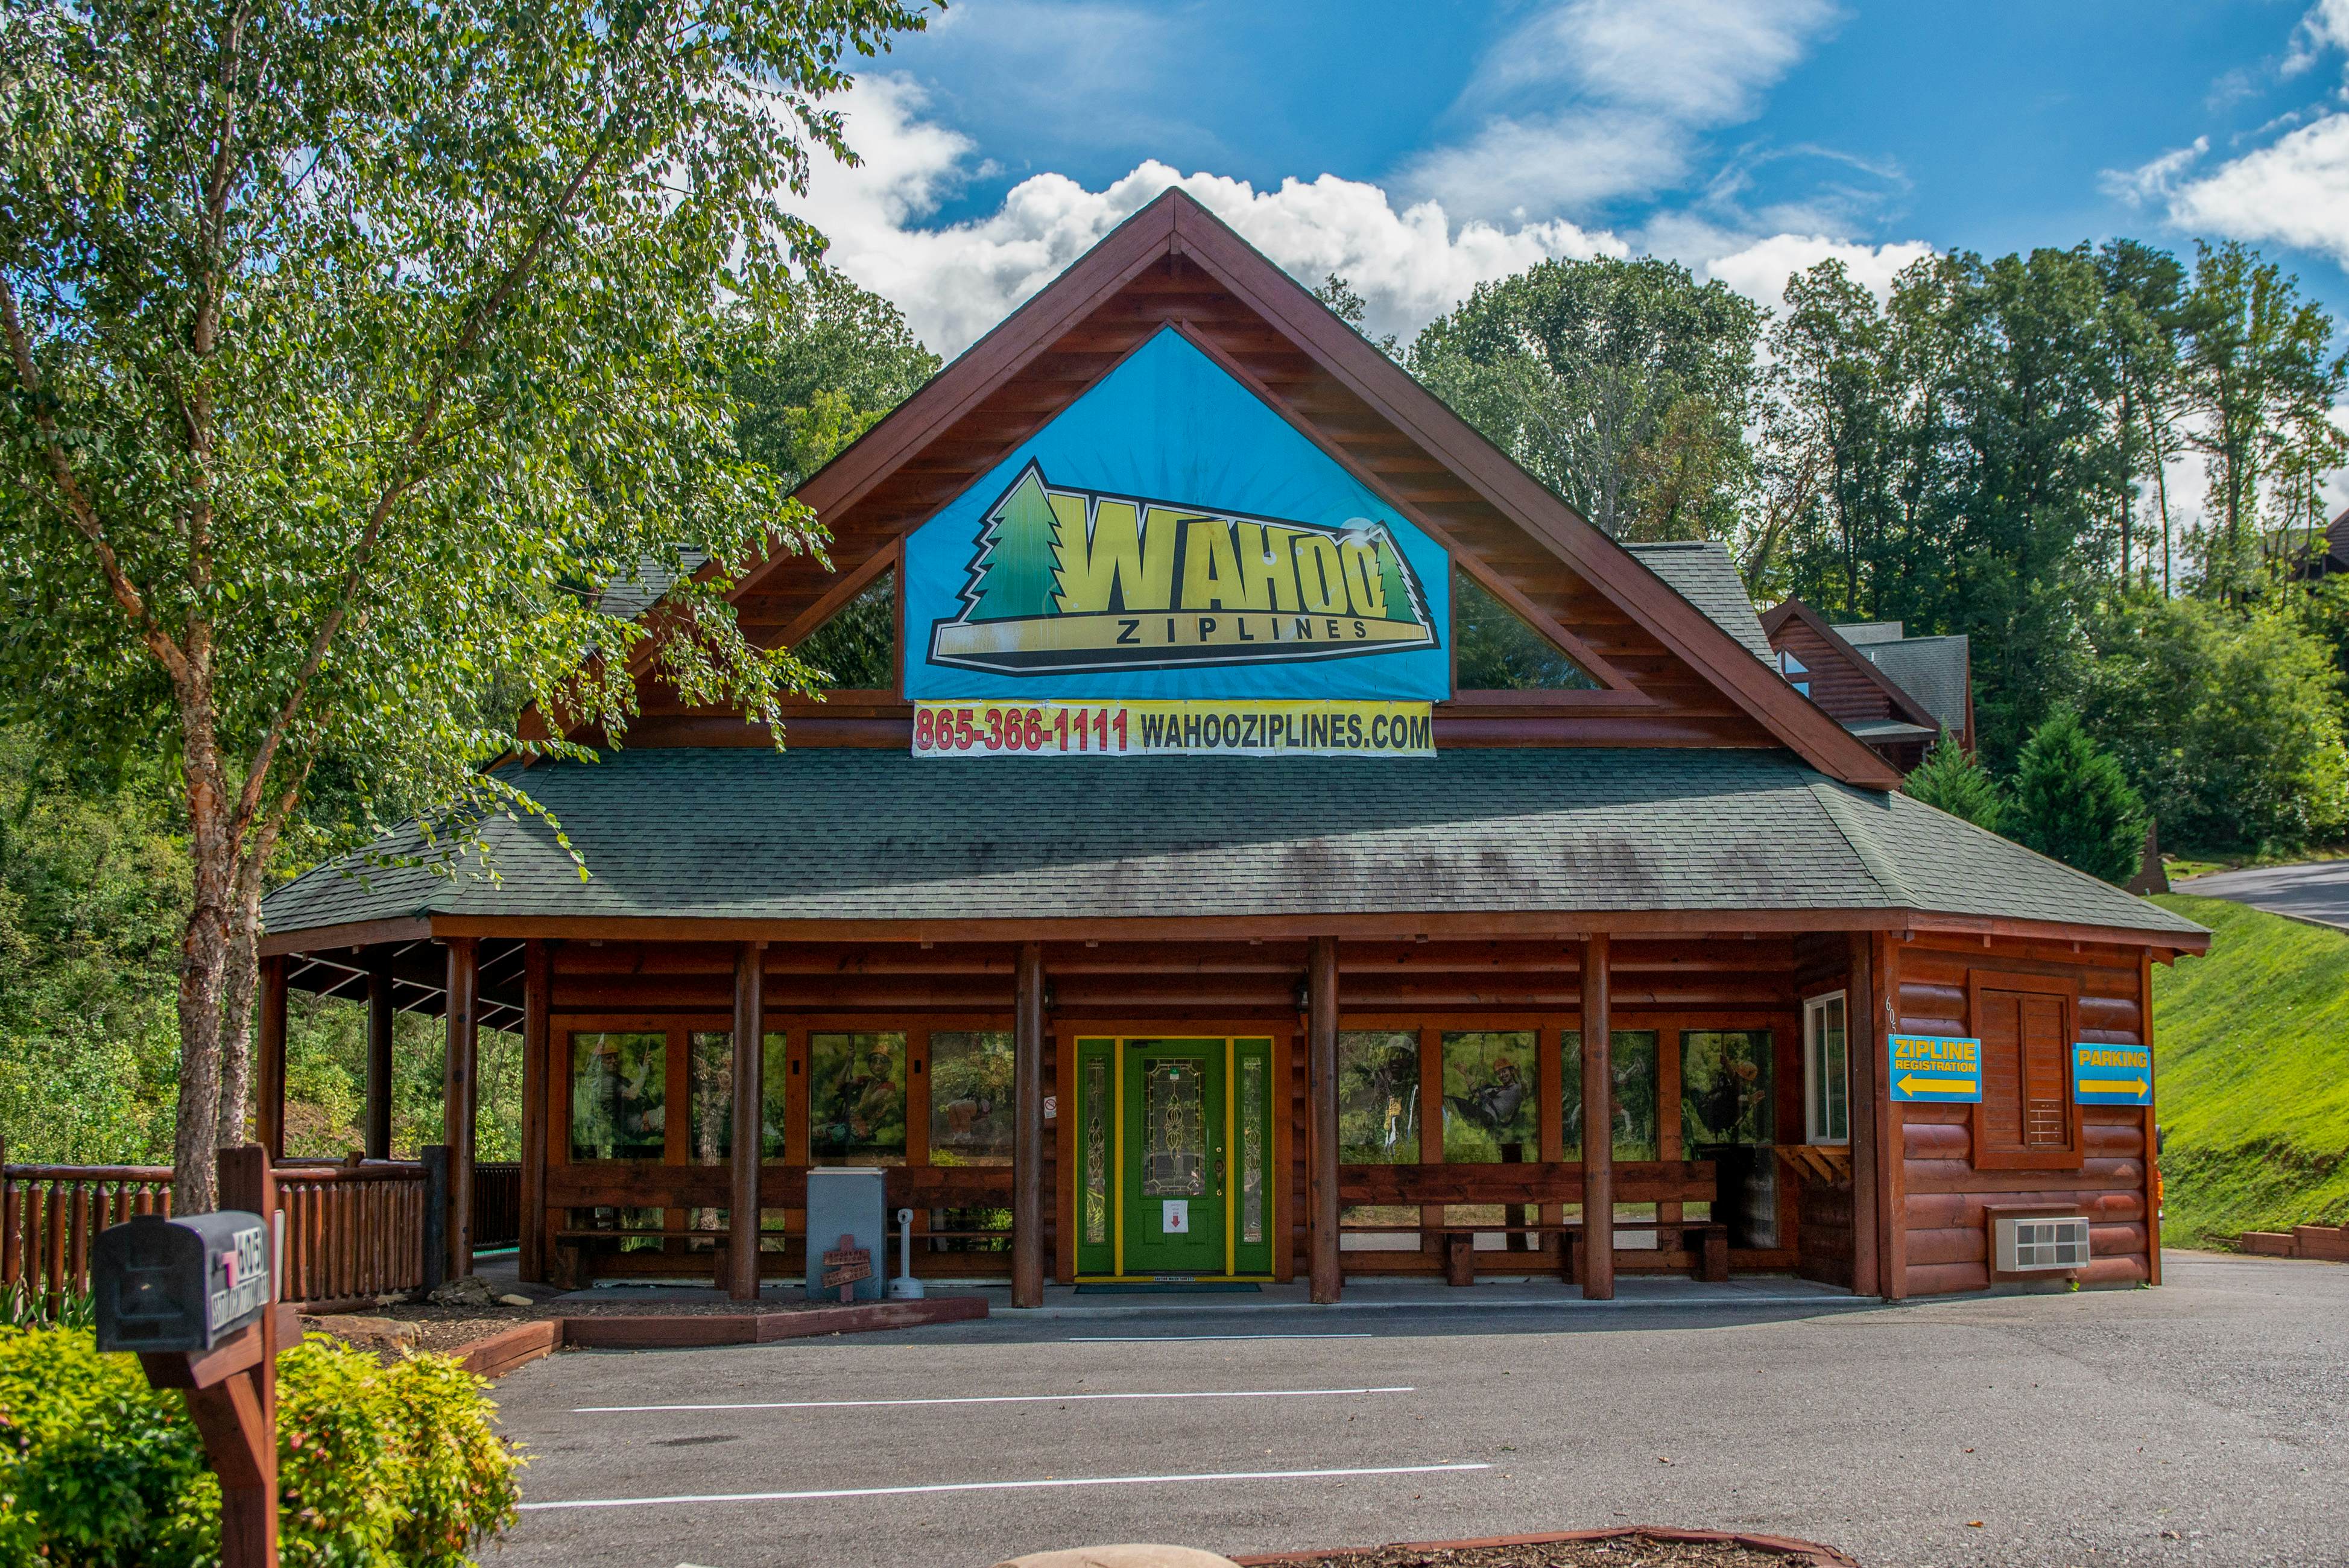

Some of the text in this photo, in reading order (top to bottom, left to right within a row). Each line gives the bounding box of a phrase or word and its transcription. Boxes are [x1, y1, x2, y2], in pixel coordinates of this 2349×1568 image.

[1048, 493, 1388, 619] WAHOO
[1116, 617, 1367, 644] ZIPLINES
[916, 709, 1429, 751] 865-366-1111 WAHOOZIPLINES.COM
[1894, 1039, 1976, 1061] ZIPLINE
[2079, 1050, 2147, 1068] PARKING
[1895, 1059, 1976, 1073] REGISTRATION
